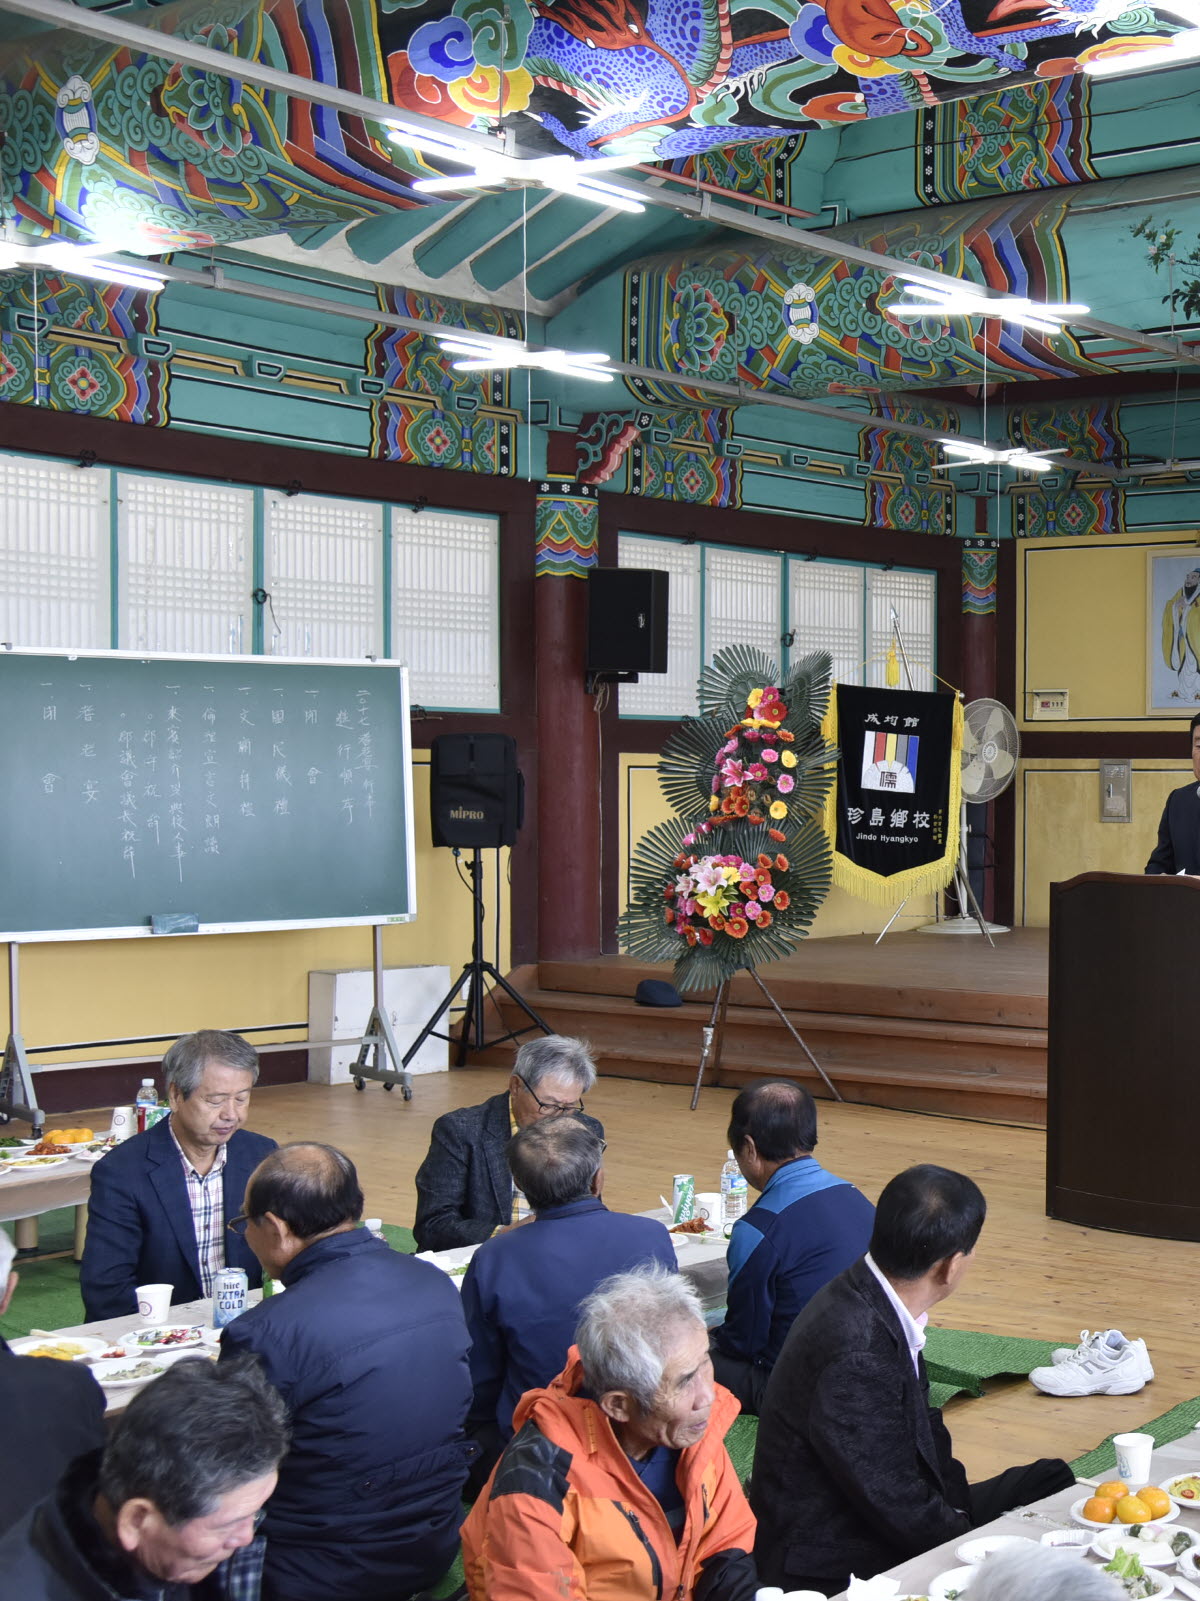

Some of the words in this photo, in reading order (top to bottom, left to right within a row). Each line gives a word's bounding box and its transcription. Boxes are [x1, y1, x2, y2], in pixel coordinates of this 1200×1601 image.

[864, 712, 920, 728] 成均館
[856, 832, 877, 842] Jindo
[880, 834, 919, 844] Hyangkyo
[217, 1289, 246, 1300] EXTRA
[219, 1299, 244, 1310] COLD
